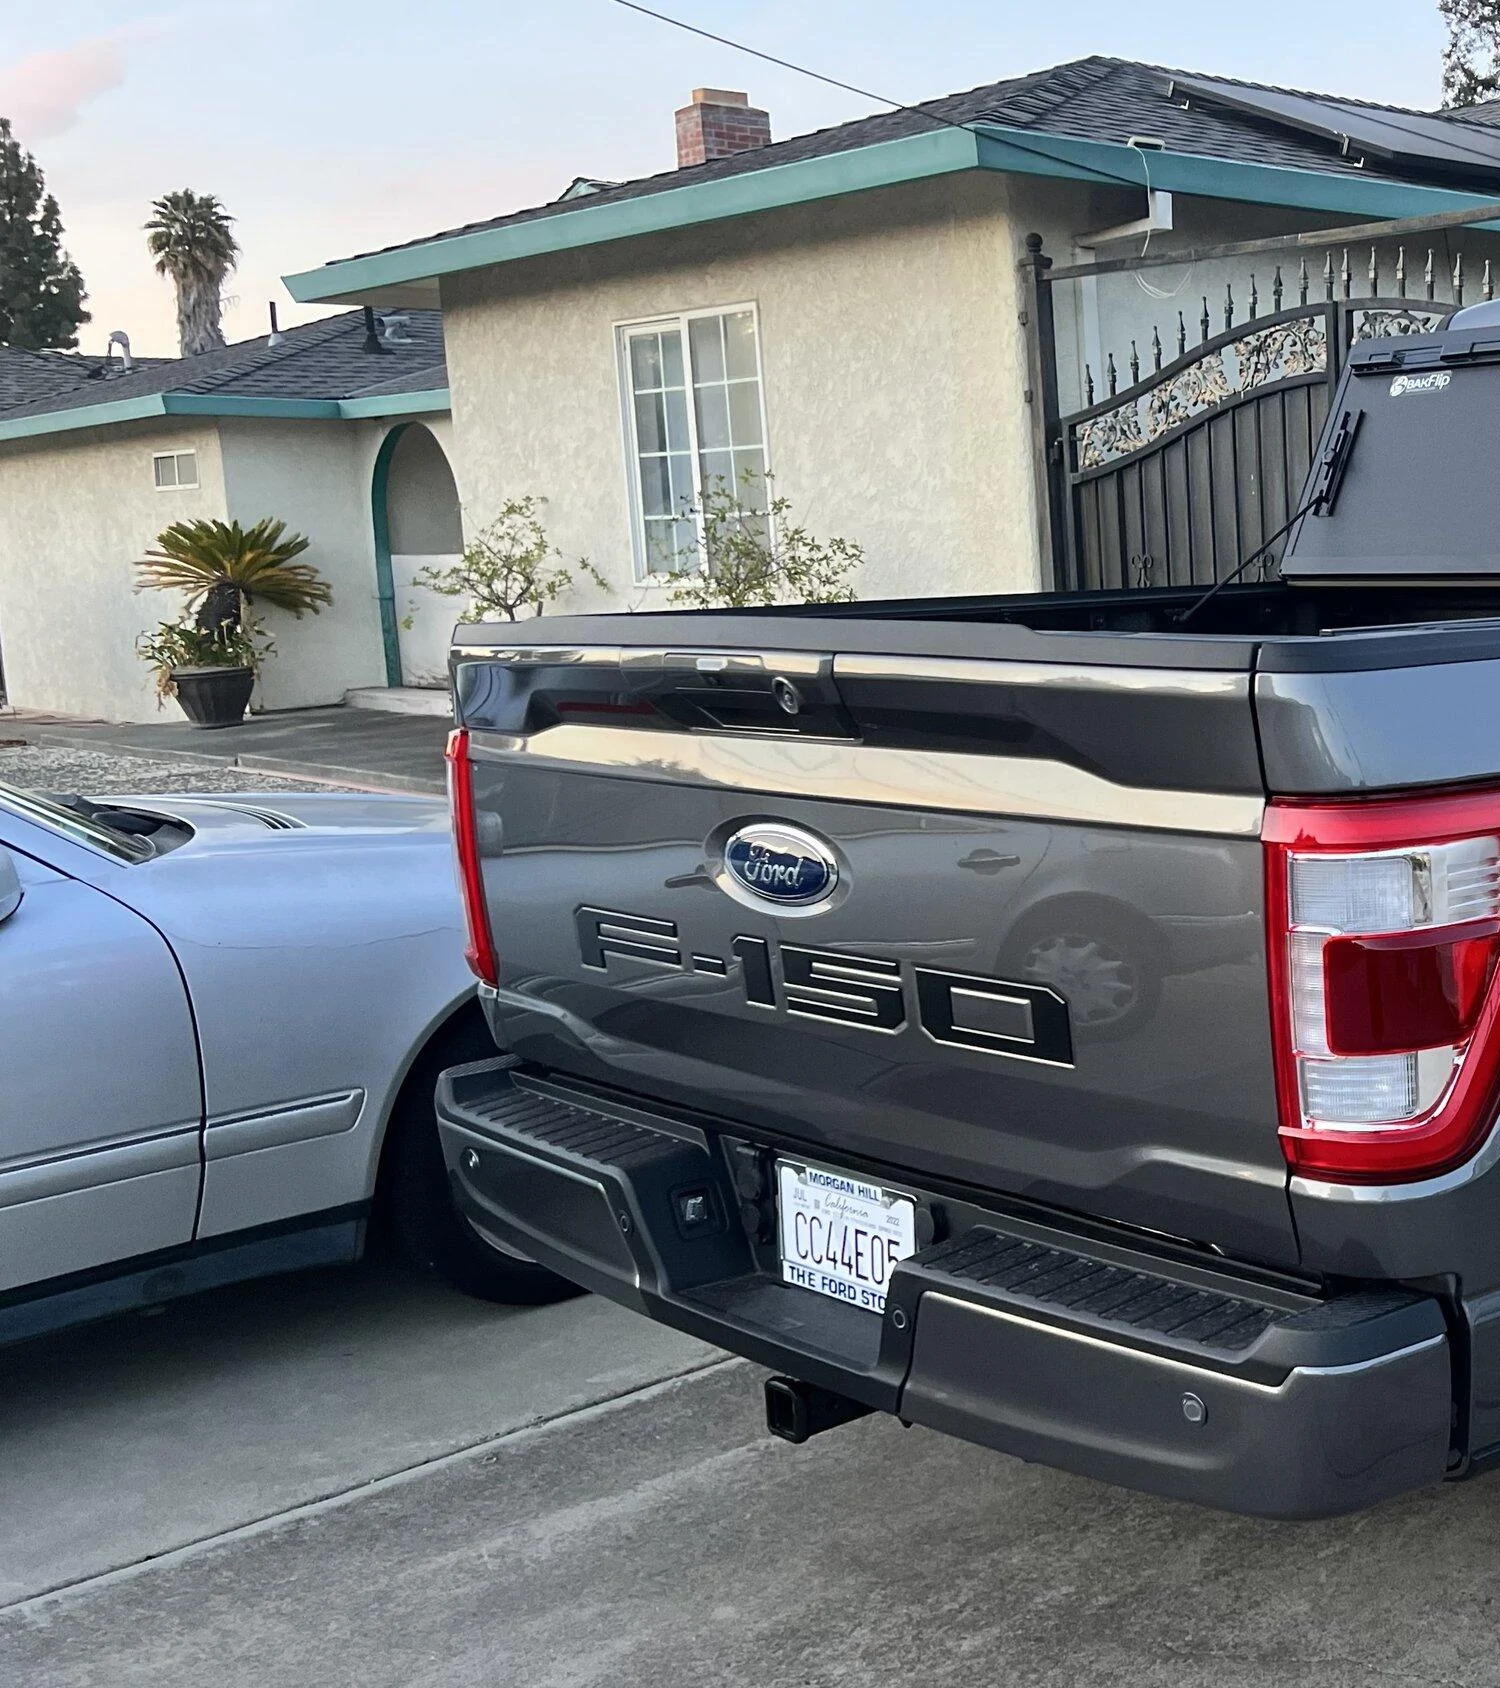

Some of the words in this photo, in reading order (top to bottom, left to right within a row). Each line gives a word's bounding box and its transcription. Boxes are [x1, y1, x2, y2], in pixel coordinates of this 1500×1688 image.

[1406, 373, 1451, 390] BAKFlip
[743, 840, 804, 889] Ford
[573, 903, 1076, 1069] F-150
[793, 1187, 807, 1202] JUL
[808, 1171, 855, 1195] MORGAN
[857, 1185, 880, 1202] HILL
[824, 1192, 869, 1219] California
[885, 1214, 900, 1227] 2022
[794, 1211, 900, 1285] CC44E05
[788, 1265, 816, 1288] THE
[821, 1276, 857, 1300] FORD
